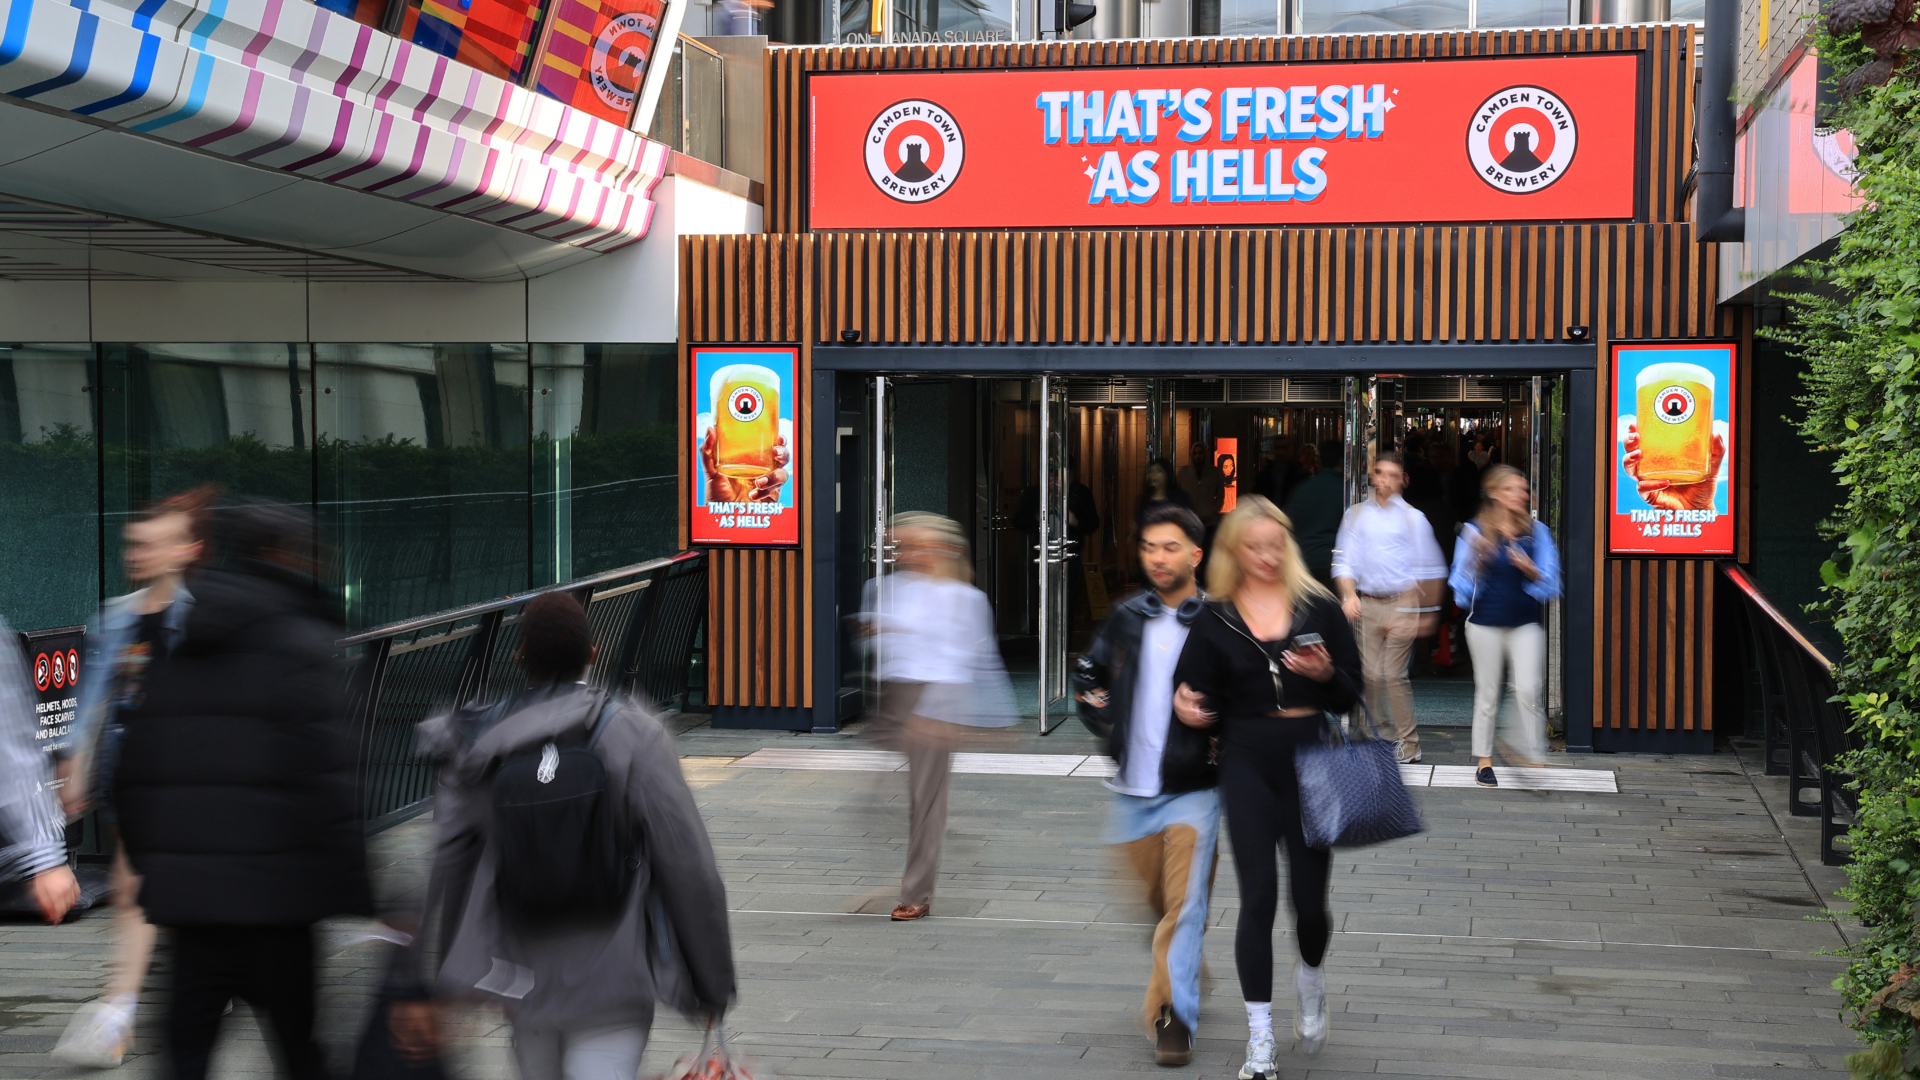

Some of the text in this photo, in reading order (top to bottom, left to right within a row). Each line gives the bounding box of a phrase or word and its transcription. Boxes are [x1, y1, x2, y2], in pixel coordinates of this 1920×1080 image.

[846, 29, 1006, 44] ONE ANADA SQUARE
[1035, 84, 1386, 144] THAT'S FRESH
[1476, 93, 1568, 133] CAMDEN TOWN
[872, 106, 956, 144] CAMDEN TOWN
[1088, 147, 1328, 204] AS HELLS
[1485, 163, 1557, 187] BREWERY
[881, 174, 947, 196] BREWERY
[730, 388, 749, 402] CAMDEN
[1657, 388, 1692, 403] CAMDEN TOWN
[707, 501, 783, 515] THAT'S FRESH
[1630, 509, 1716, 522] THAT'S FRESH
[719, 515, 771, 528] AS HELLS
[1642, 524, 1702, 537] AS HELLS
[35, 700, 61, 713] HELMETS,
[39, 711, 75, 727] FACE SCARVES
[34, 729, 48, 740] AND
